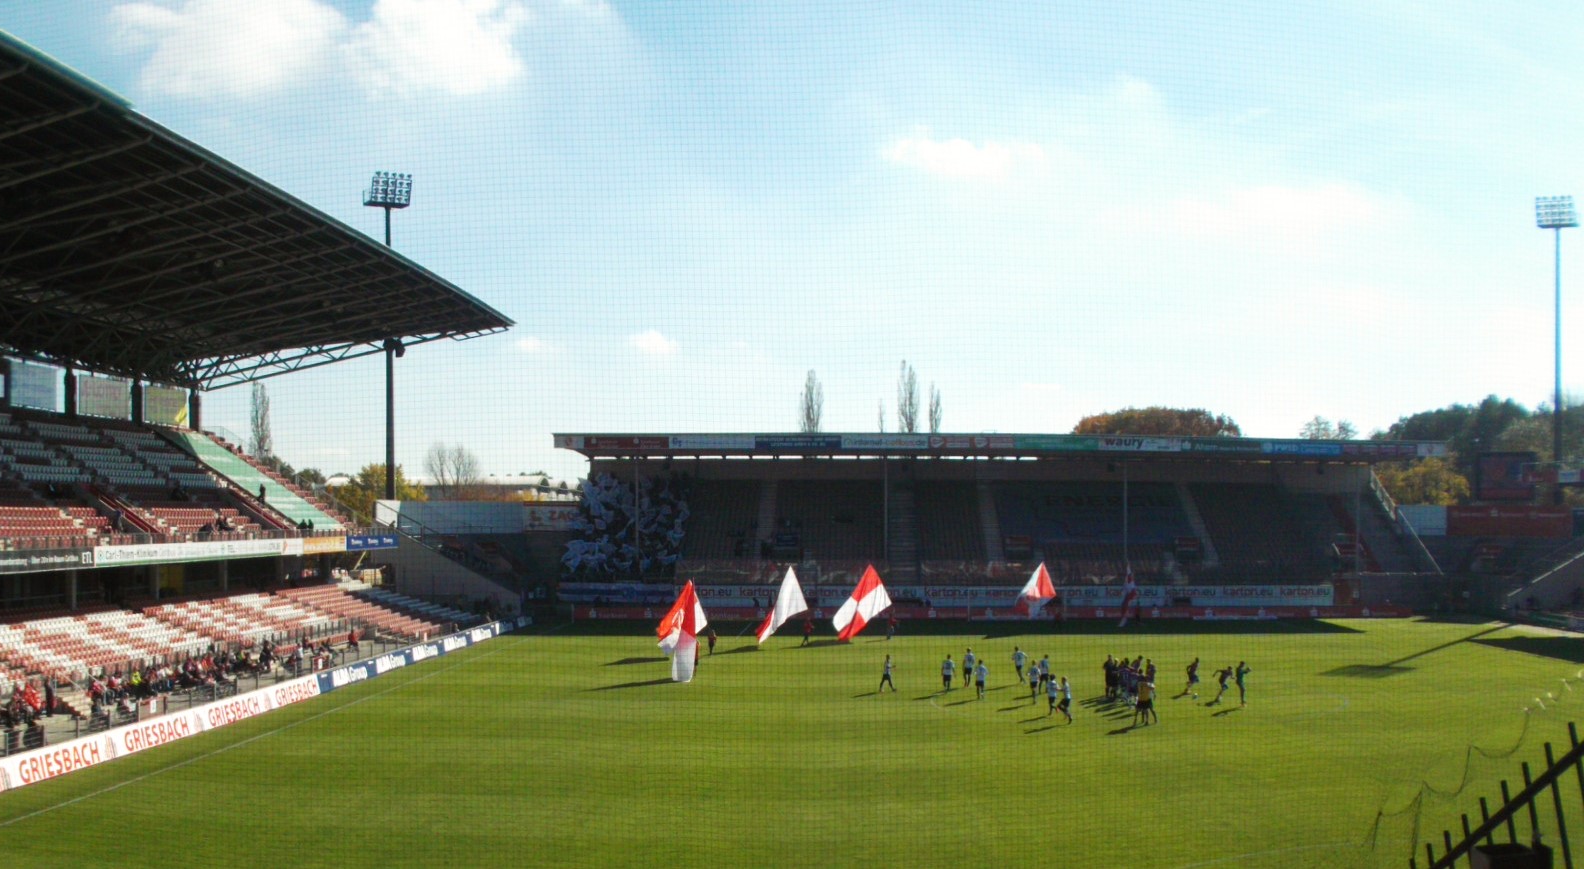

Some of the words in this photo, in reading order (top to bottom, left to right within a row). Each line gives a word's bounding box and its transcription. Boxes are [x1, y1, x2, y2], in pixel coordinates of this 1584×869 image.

[1104, 438, 1144, 450] waury
[925, 586, 978, 598] karton.eu
[1166, 586, 1216, 598] karton.eu
[1222, 586, 1273, 598] karton.eu
[1279, 586, 1330, 598] karton.eu
[348, 665, 368, 684] Group
[275, 679, 318, 707] GRIESBACH
[208, 697, 261, 728] GRIESBACH
[124, 716, 190, 751] GRIESBACH
[18, 741, 101, 784] GRIESBACH
